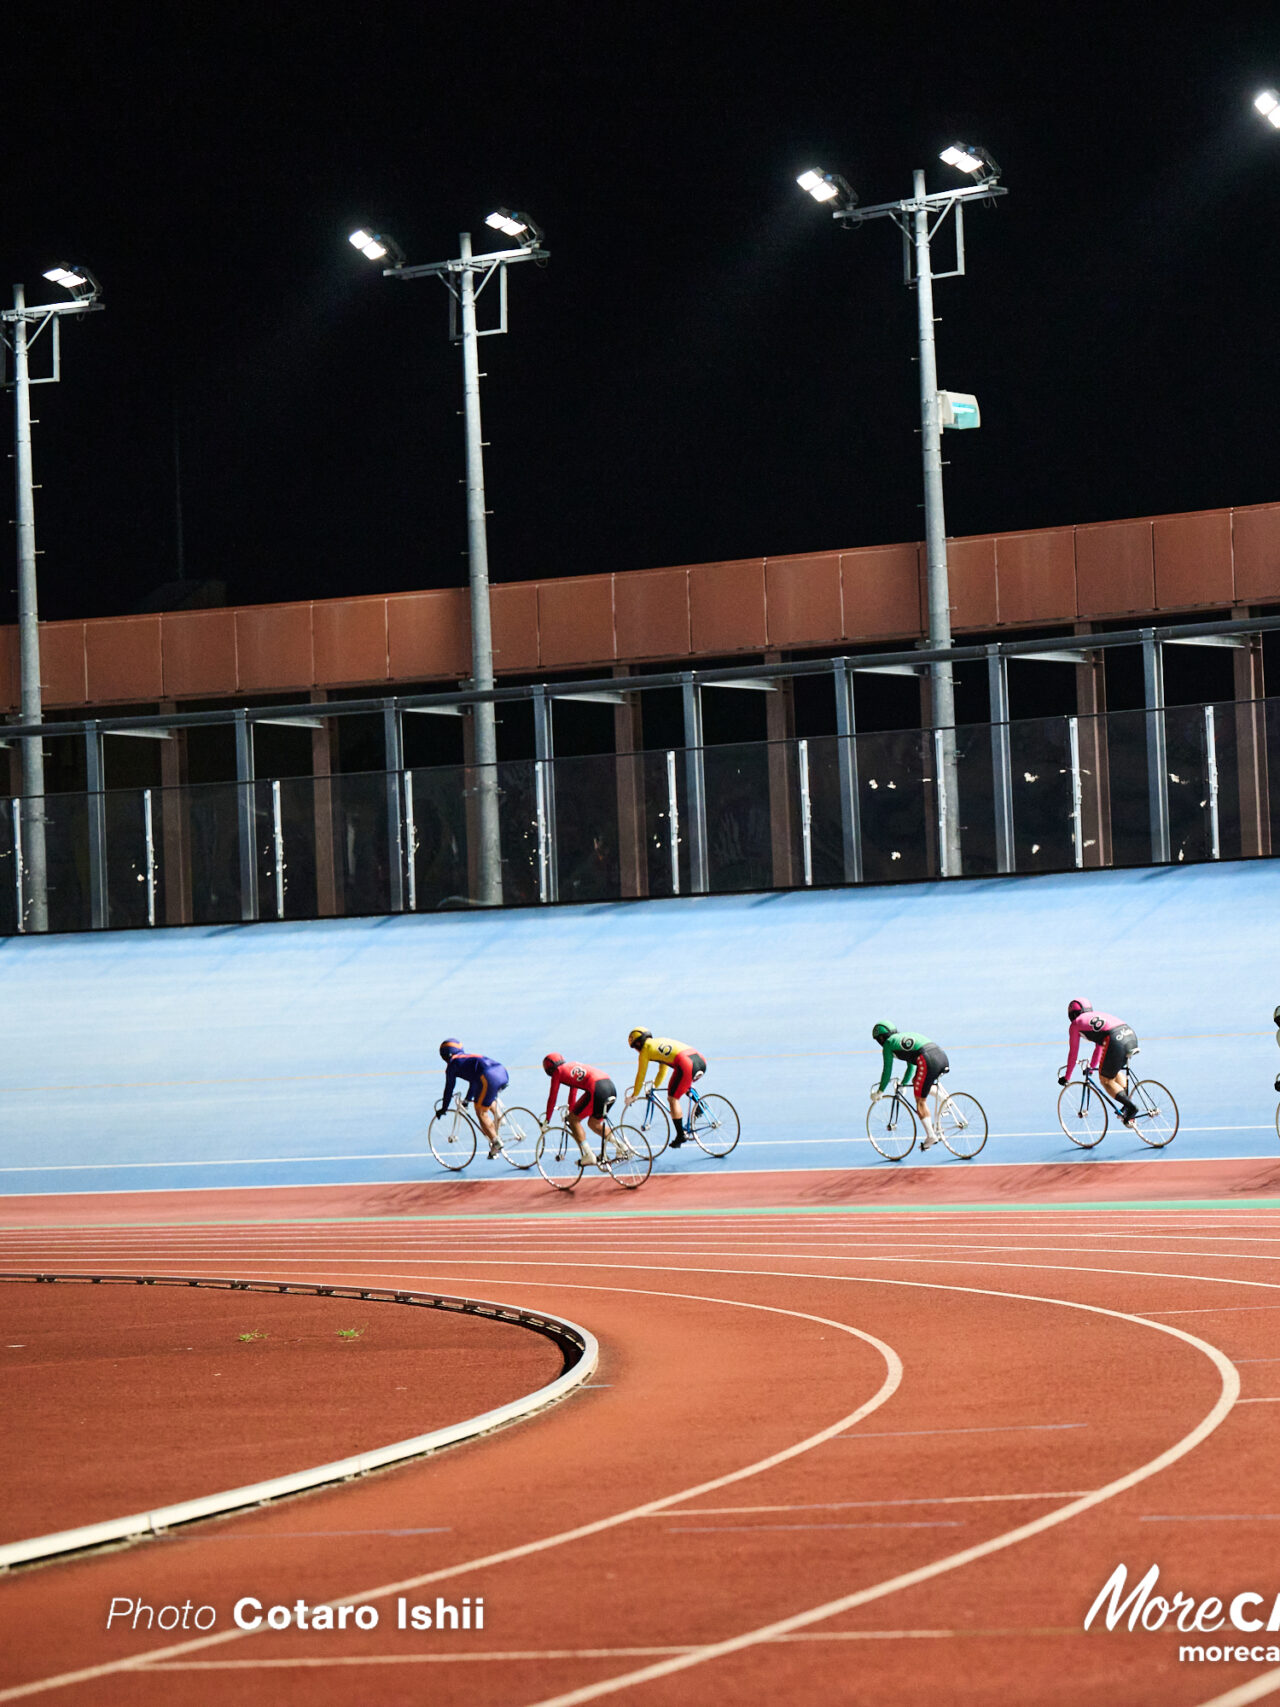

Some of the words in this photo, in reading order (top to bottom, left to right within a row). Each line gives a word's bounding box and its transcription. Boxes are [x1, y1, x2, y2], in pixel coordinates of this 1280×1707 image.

[1089, 1016, 1104, 1031] 8
[658, 1043, 673, 1056] 5
[901, 1037, 916, 1051] 6
[571, 1066, 587, 1081] 3
